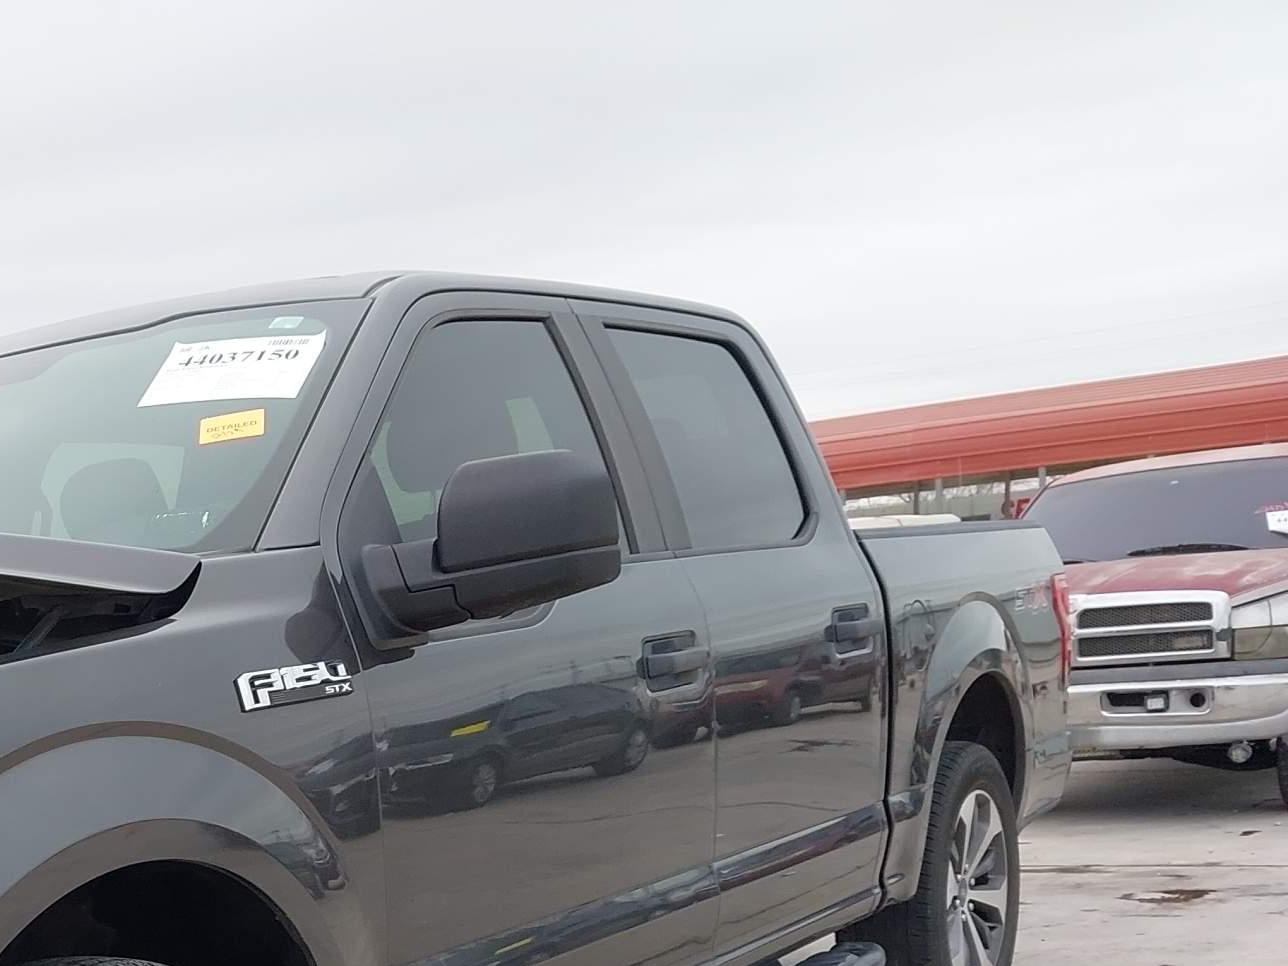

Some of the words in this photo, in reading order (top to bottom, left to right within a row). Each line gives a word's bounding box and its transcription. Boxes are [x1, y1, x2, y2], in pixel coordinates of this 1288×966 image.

[178, 348, 300, 368] 44037150
[206, 420, 258, 433] DETAILED
[324, 682, 352, 695] STX
